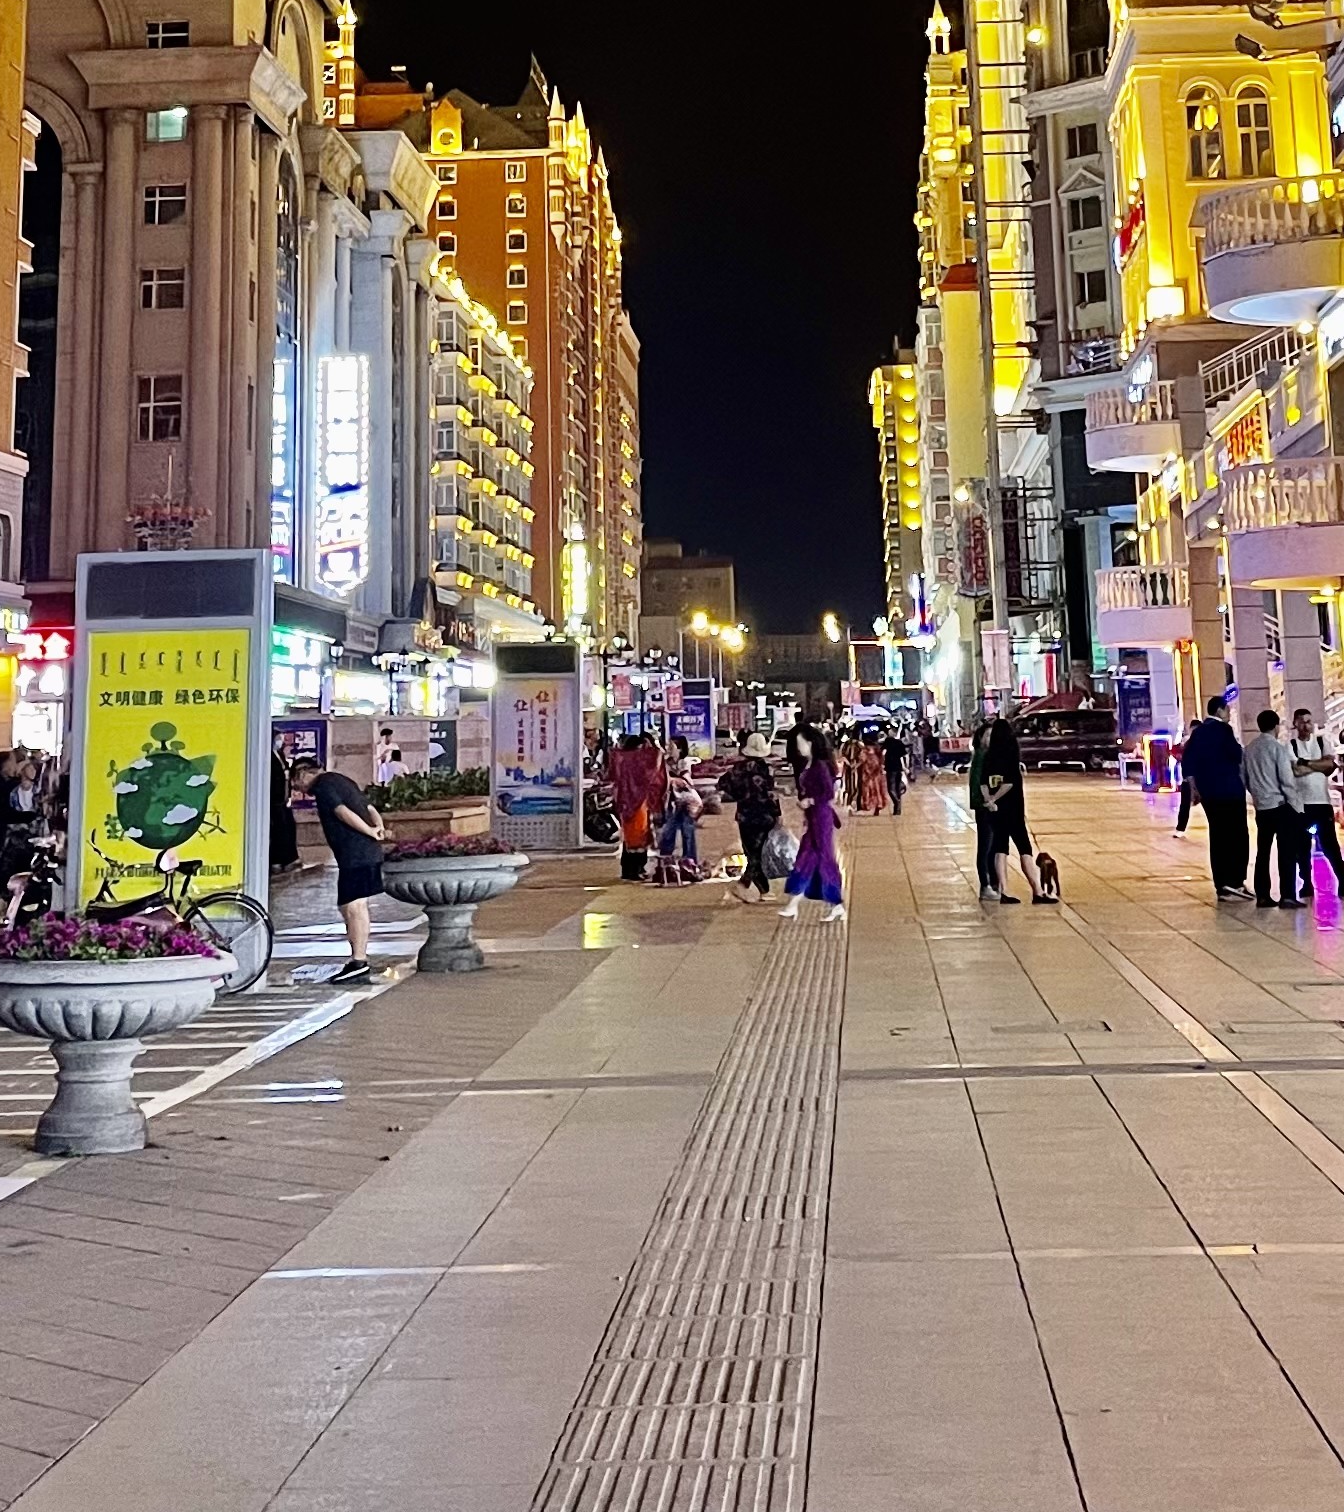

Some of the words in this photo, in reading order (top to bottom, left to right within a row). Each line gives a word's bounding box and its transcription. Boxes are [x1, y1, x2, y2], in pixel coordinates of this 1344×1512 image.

[99, 690, 164, 707] 文明健康
[175, 688, 240, 705] 绿色环保
